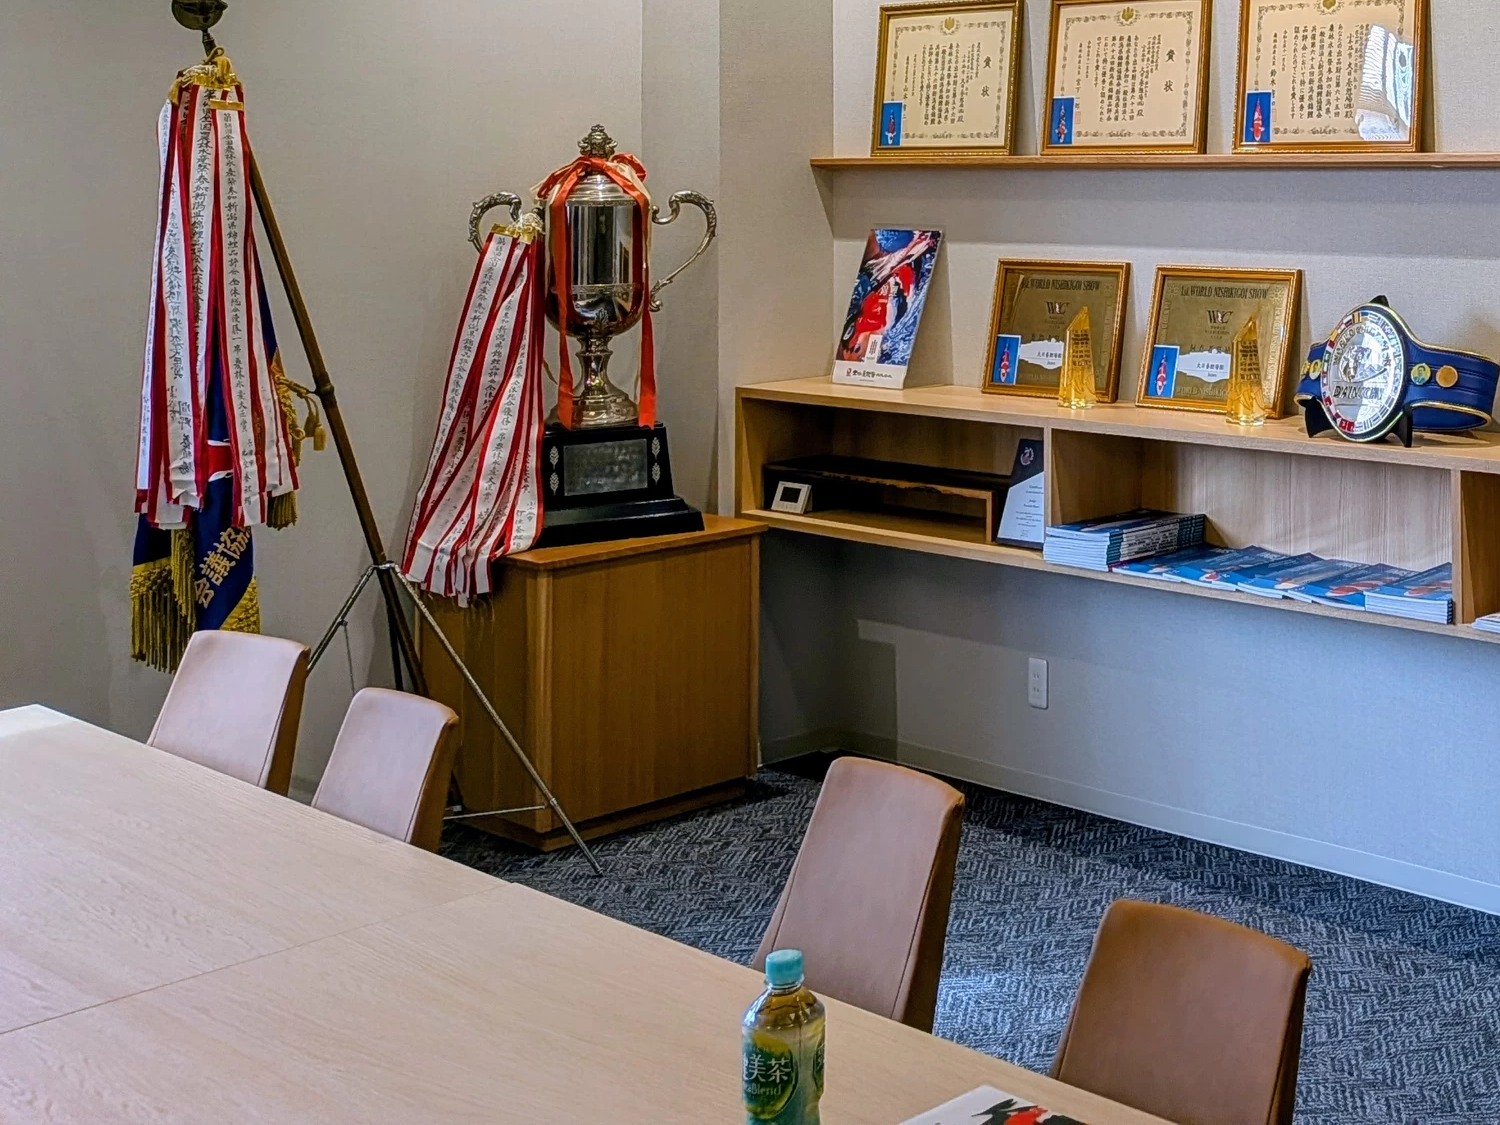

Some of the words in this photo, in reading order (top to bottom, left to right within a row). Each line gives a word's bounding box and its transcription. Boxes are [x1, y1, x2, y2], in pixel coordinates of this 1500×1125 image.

[1164, 49, 1176, 92] 賞状
[1031, 278, 1051, 290] WORLD
[1083, 280, 1100, 291] SHOW
[1191, 287, 1211, 296] WORLD
[1213, 286, 1247, 298] NISHIKIGOI
[1250, 287, 1268, 299] SHOW
